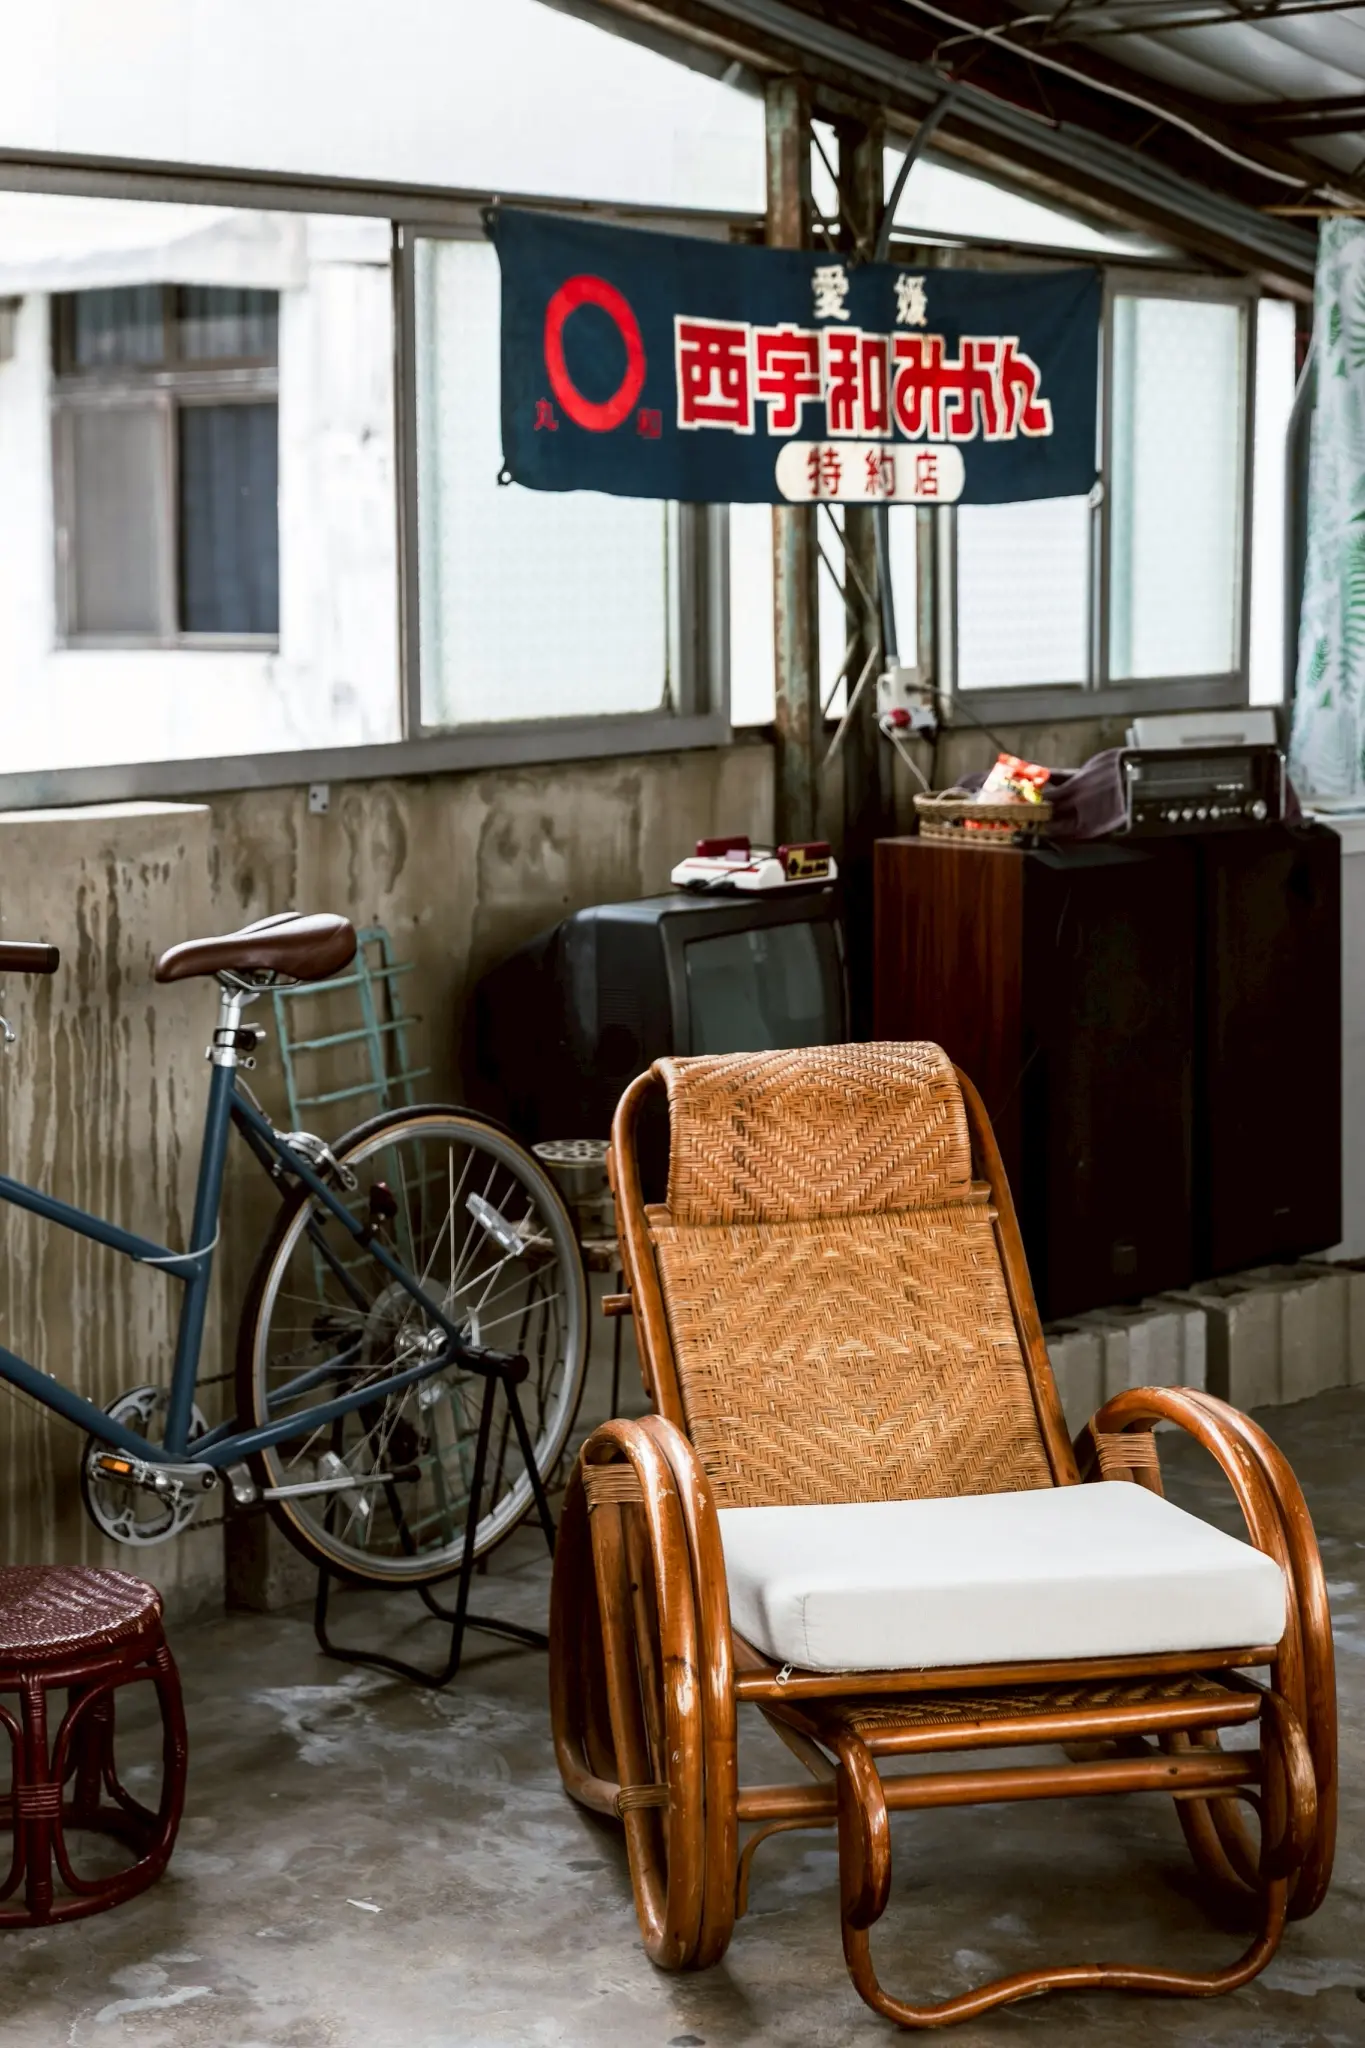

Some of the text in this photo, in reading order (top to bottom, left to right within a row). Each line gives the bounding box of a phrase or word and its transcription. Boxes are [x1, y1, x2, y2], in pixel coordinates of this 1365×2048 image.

[674, 313, 1053, 441] 西宇和みかん
[806, 446, 940, 497] 特約店
